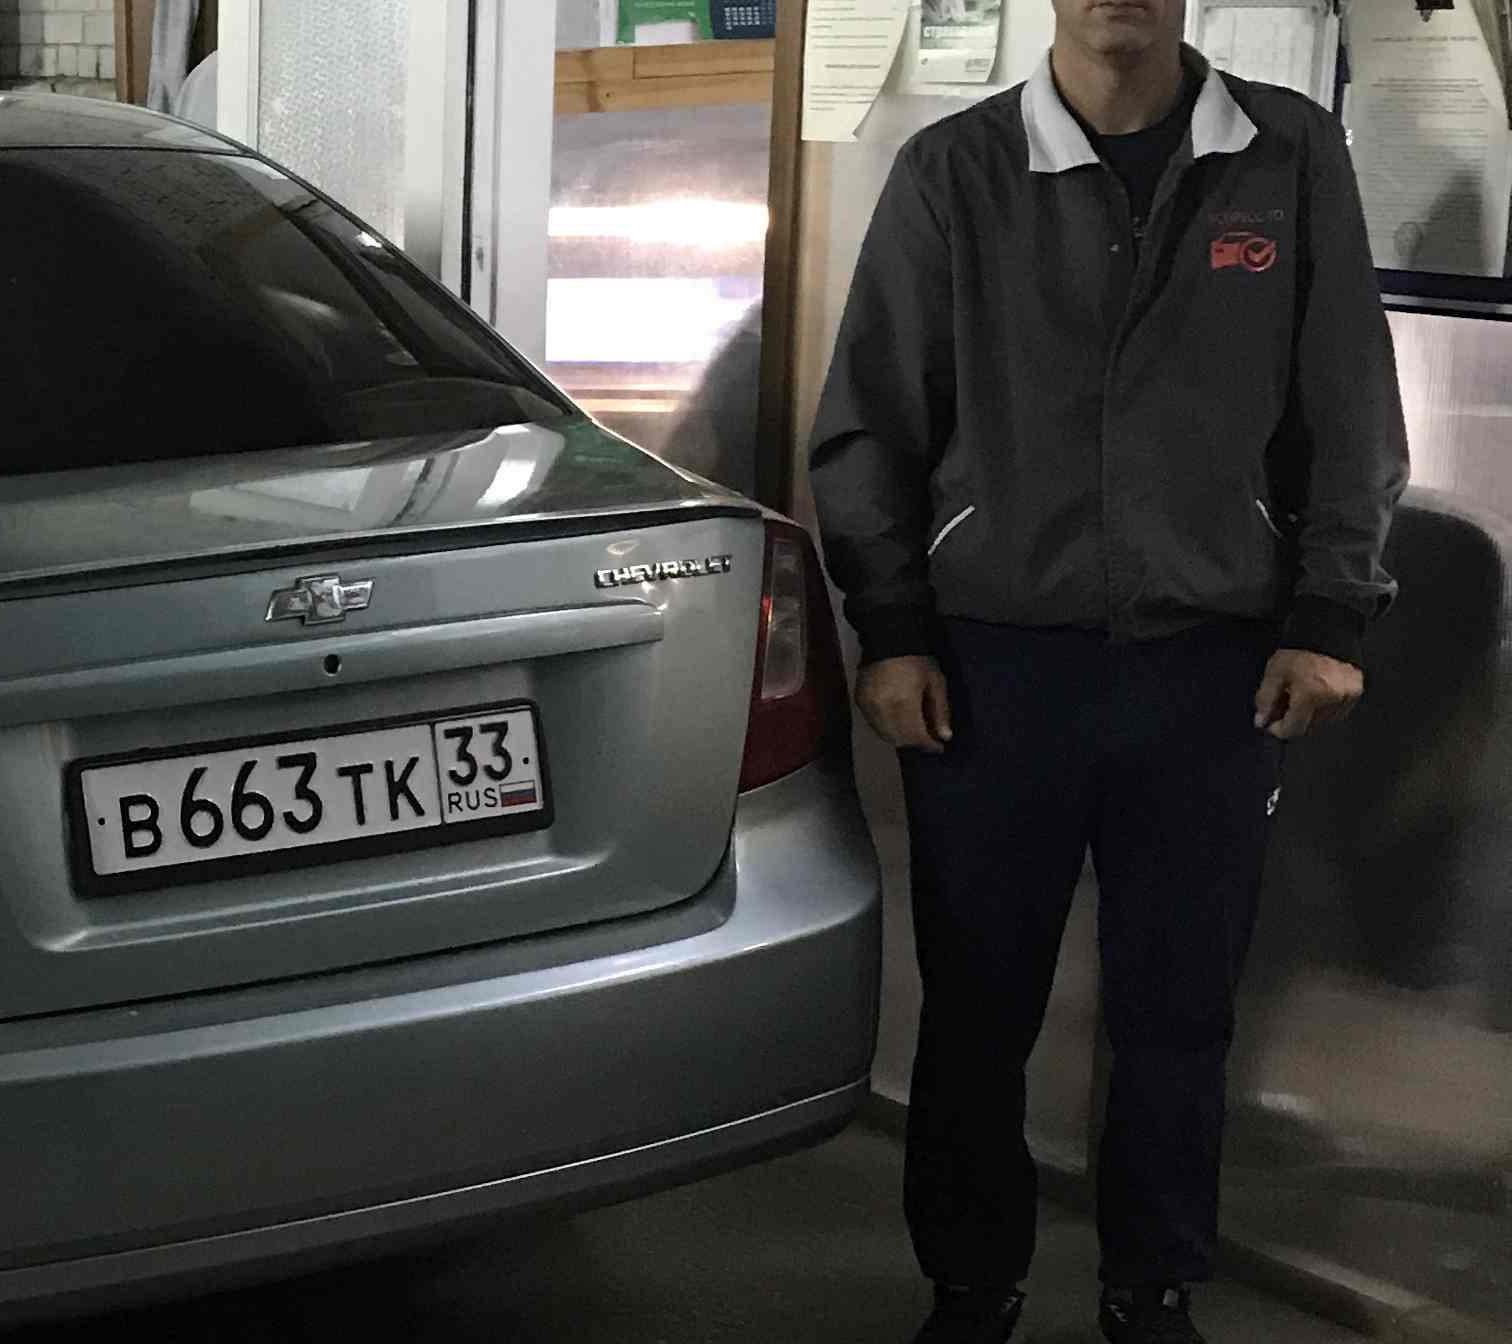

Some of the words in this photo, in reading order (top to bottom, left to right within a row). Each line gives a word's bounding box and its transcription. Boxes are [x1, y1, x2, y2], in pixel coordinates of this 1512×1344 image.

[594, 554, 733, 588] CHEVROLET
[444, 721, 513, 786] 33
[448, 787, 498, 814] RUS
